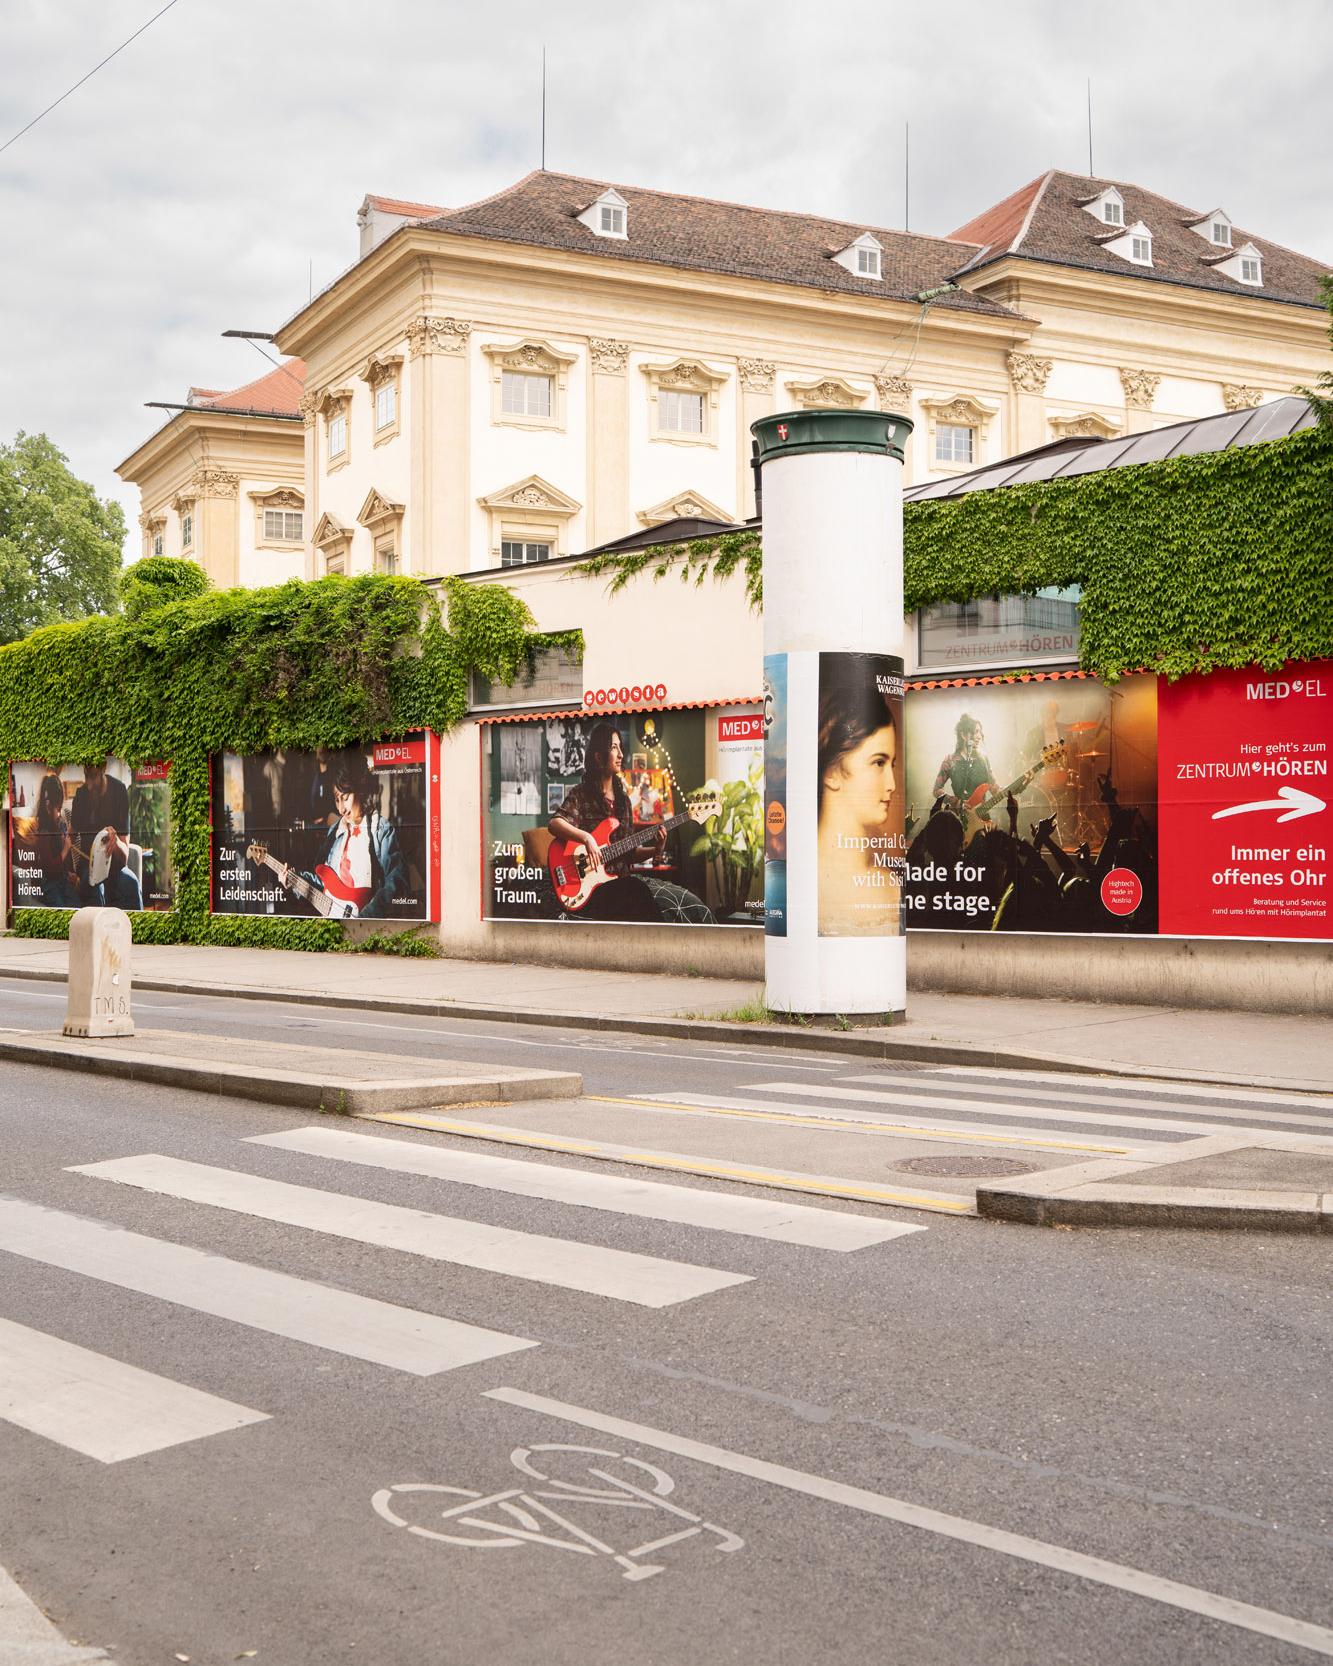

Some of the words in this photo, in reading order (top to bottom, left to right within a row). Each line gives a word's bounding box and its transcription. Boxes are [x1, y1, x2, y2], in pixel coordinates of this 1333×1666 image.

[945, 641, 1009, 659] ZENTRUM
[1020, 634, 1073, 652] HÖREN
[585, 685, 666, 705] gewista
[1246, 682, 1290, 700] MED
[1240, 743, 1263, 754] Hier
[1265, 741, 1299, 756] geht's
[1302, 742, 1326, 752] zum
[1176, 763, 1251, 779] ZENTRUM
[1263, 757, 1327, 777] HÖREN
[494, 840, 524, 857] Zum
[836, 832, 897, 852] Imperial
[17, 849, 36, 861] Vom
[220, 847, 236, 861] Zur
[1231, 845, 1291, 861] Immer
[1296, 844, 1326, 861] ein
[18, 866, 43, 879] ersten
[220, 868, 251, 881] ersten
[494, 863, 543, 884] großen
[852, 871, 885, 887] with
[954, 861, 986, 882] for
[1212, 868, 1284, 886] offenes
[1290, 868, 1327, 886] Ohr
[18, 882, 44, 896] Hören.
[1108, 880, 1135, 888] Hightech
[220, 886, 287, 902] Leidenschaft.
[391, 897, 418, 905] medel.com
[494, 887, 541, 904] Traum.
[932, 891, 997, 916] stage.
[1253, 898, 1284, 907] Beratung
[1286, 898, 1299, 906] und
[1300, 898, 1327, 906] Service
[1280, 909, 1327, 917] Hörimplantat
